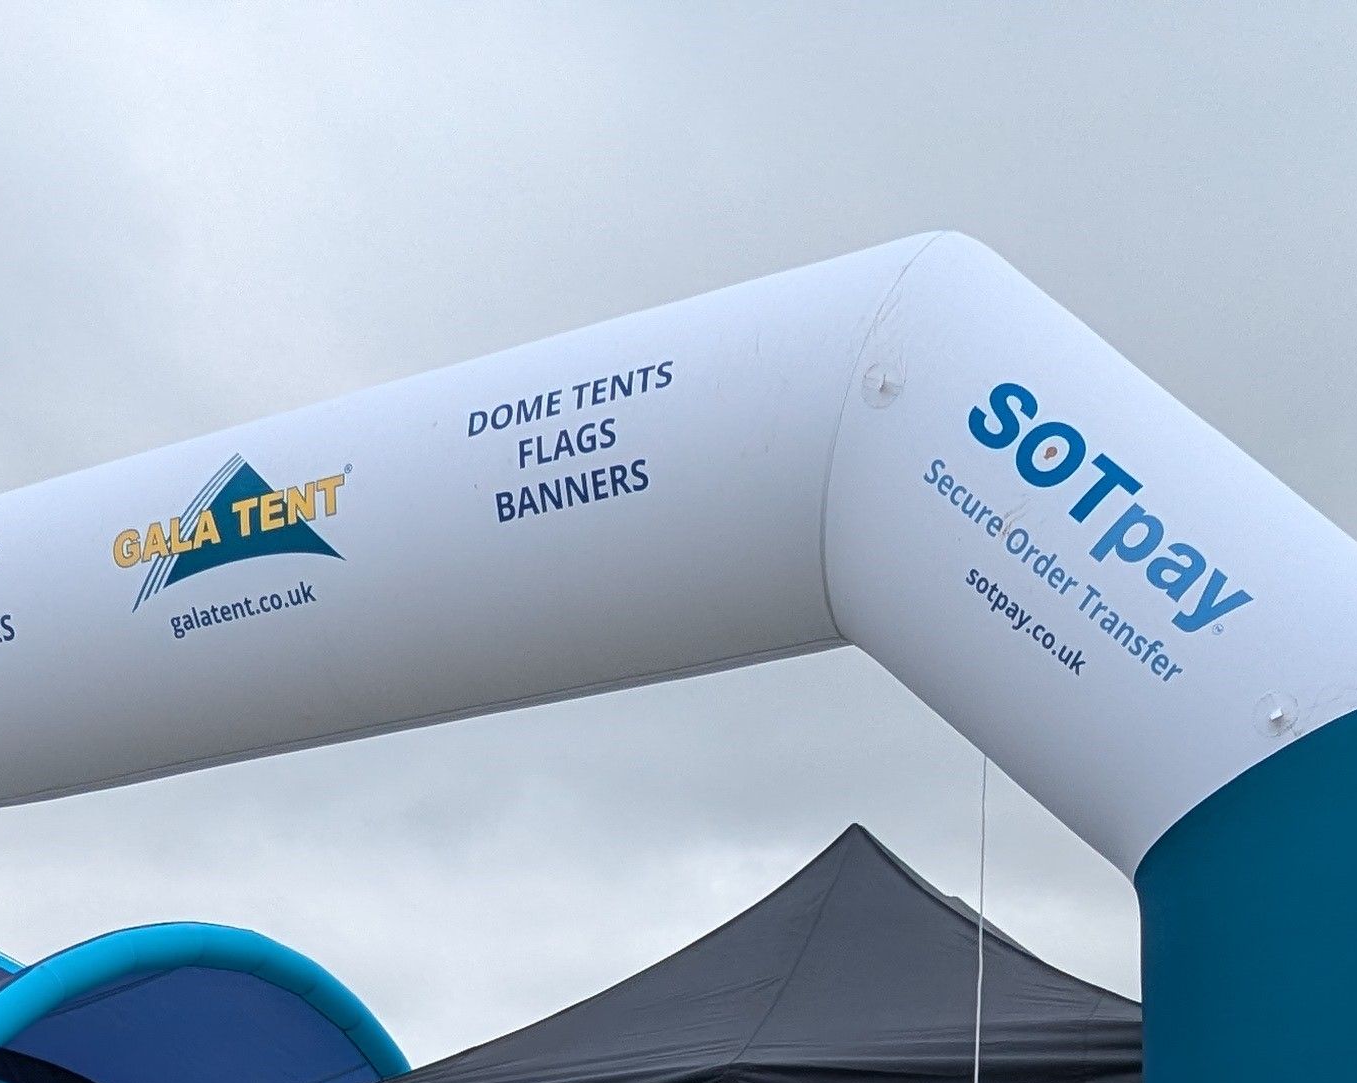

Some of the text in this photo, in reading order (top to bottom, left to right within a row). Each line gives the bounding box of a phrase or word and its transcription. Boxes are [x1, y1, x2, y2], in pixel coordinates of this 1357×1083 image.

[467, 360, 674, 437] DOME TENTS
[518, 417, 616, 469] FLAGS
[495, 459, 649, 523] BANNERS
[112, 508, 221, 569] GALA
[922, 458, 1184, 683] Secure Order Transfer
[170, 581, 317, 639] galatent.co.uk
[965, 567, 1086, 677] sotpay.co.uk
